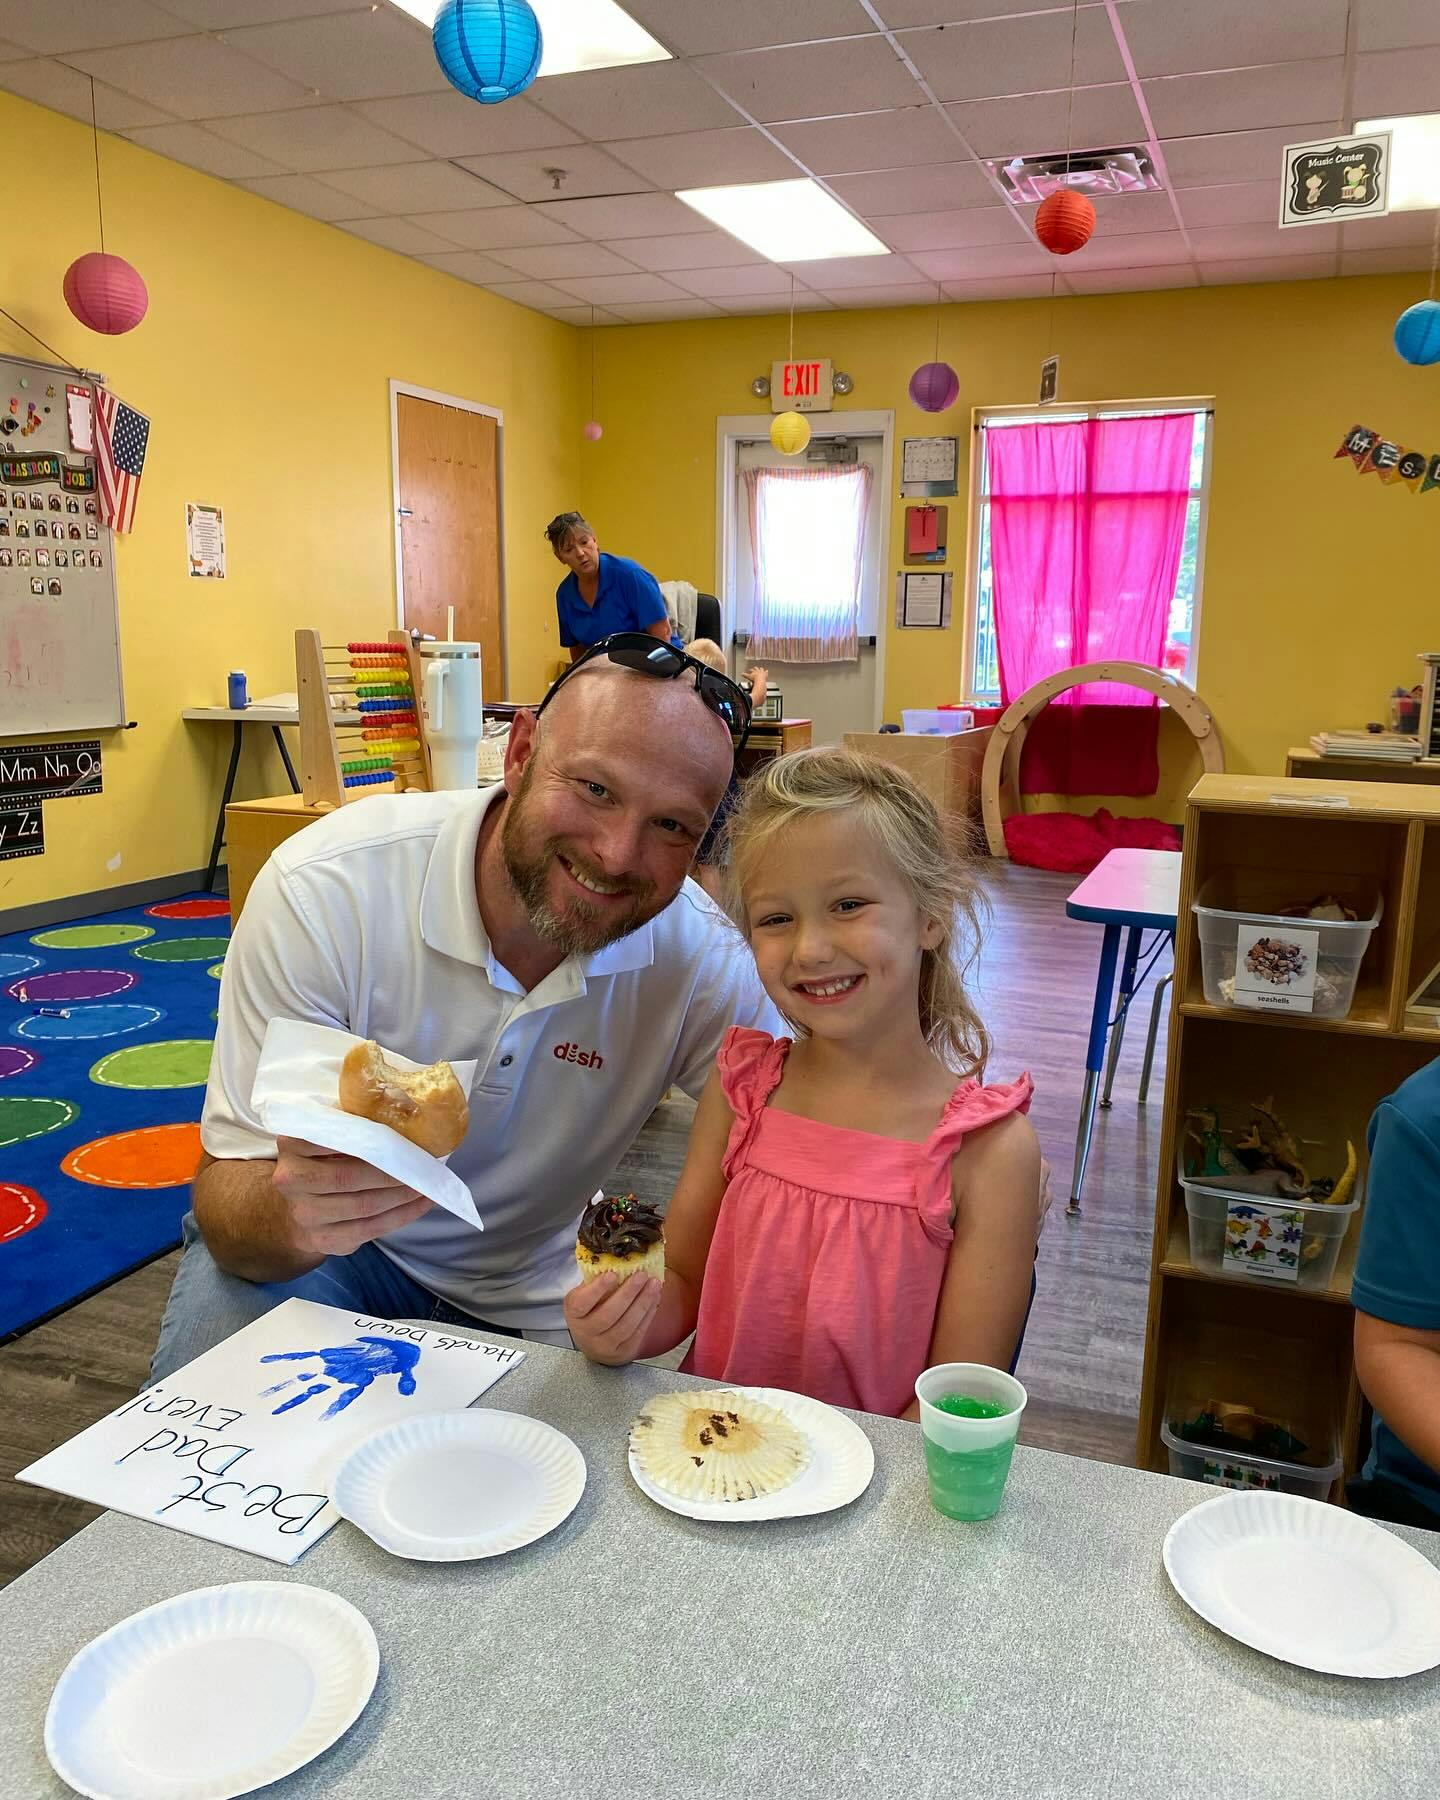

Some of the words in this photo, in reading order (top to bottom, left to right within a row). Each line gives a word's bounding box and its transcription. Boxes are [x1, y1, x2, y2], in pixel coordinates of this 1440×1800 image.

[1308, 156, 1333, 168] Music
[1335, 152, 1365, 164] Center
[783, 363, 822, 397] EXIT
[3, 460, 59, 477] CLASSROOM
[65, 471, 92, 488] JOBS
[0, 757, 37, 783] Mm
[44, 754, 70, 779] Nn
[17, 811, 39, 836] Zz
[1257, 996, 1290, 1005] seashells
[553, 1042, 604, 1070] dish
[354, 1317, 428, 1343] Down
[436, 1335, 518, 1364] Hands
[117, 1388, 247, 1431] Ever!
[113, 1427, 256, 1478] Dad
[155, 1474, 330, 1537] Best
